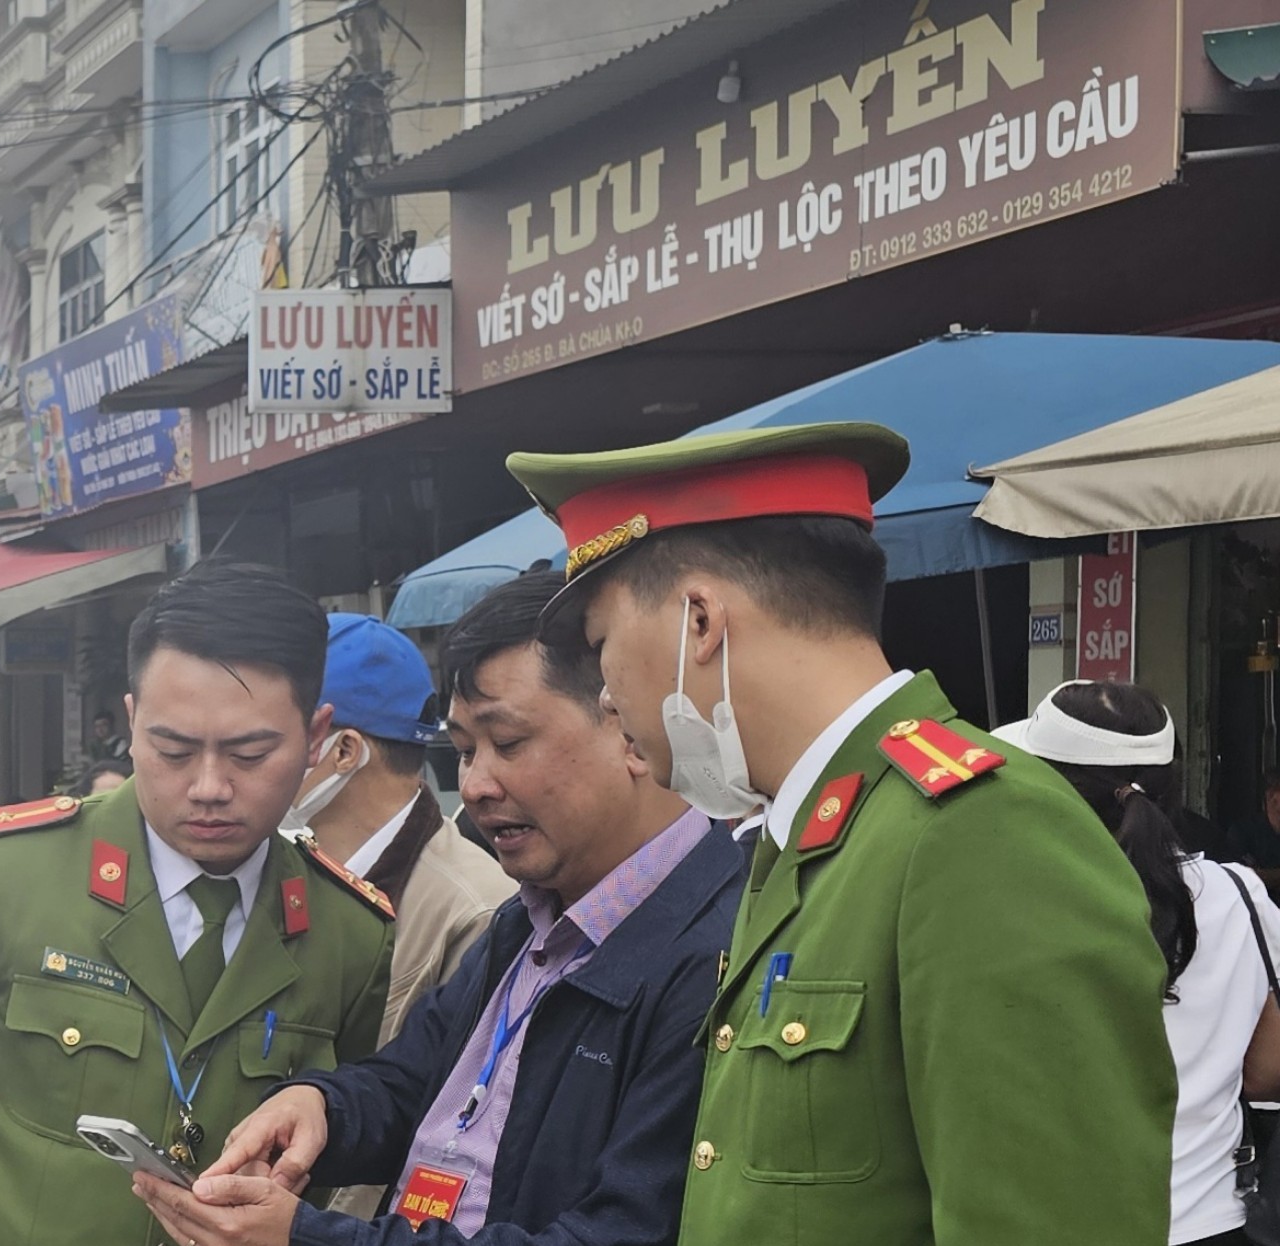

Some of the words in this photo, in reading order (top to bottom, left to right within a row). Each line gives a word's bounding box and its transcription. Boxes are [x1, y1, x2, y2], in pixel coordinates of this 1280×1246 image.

[477, 282, 526, 348] VIẾT
[531, 270, 565, 330] SỚ
[584, 244, 639, 312] SẮP
[647, 223, 679, 293] LỄ
[704, 208, 763, 273] THỤ
[779, 181, 842, 253] LỘC
[854, 146, 947, 224] THEO
[959, 112, 1036, 188] YÊU
[1047, 66, 1139, 158] CẦU
[507, 147, 664, 274] LƯU
[880, 232, 916, 261] 0912
[922, 220, 952, 249] 333
[957, 209, 988, 237] 632
[1003, 194, 1043, 225] 0129
[1049, 179, 1083, 210] 354
[1089, 164, 1132, 195] 4212
[260, 301, 324, 350] LƯU
[336, 291, 438, 350] LUYẾN
[259, 357, 305, 400] VIẾT
[313, 359, 342, 400] SỚ
[365, 356, 409, 400] SẮP
[417, 357, 441, 400] LỄ
[1093, 570, 1123, 608] SỚ
[1033, 619, 1058, 641] 265
[1085, 618, 1129, 661] SẮP
